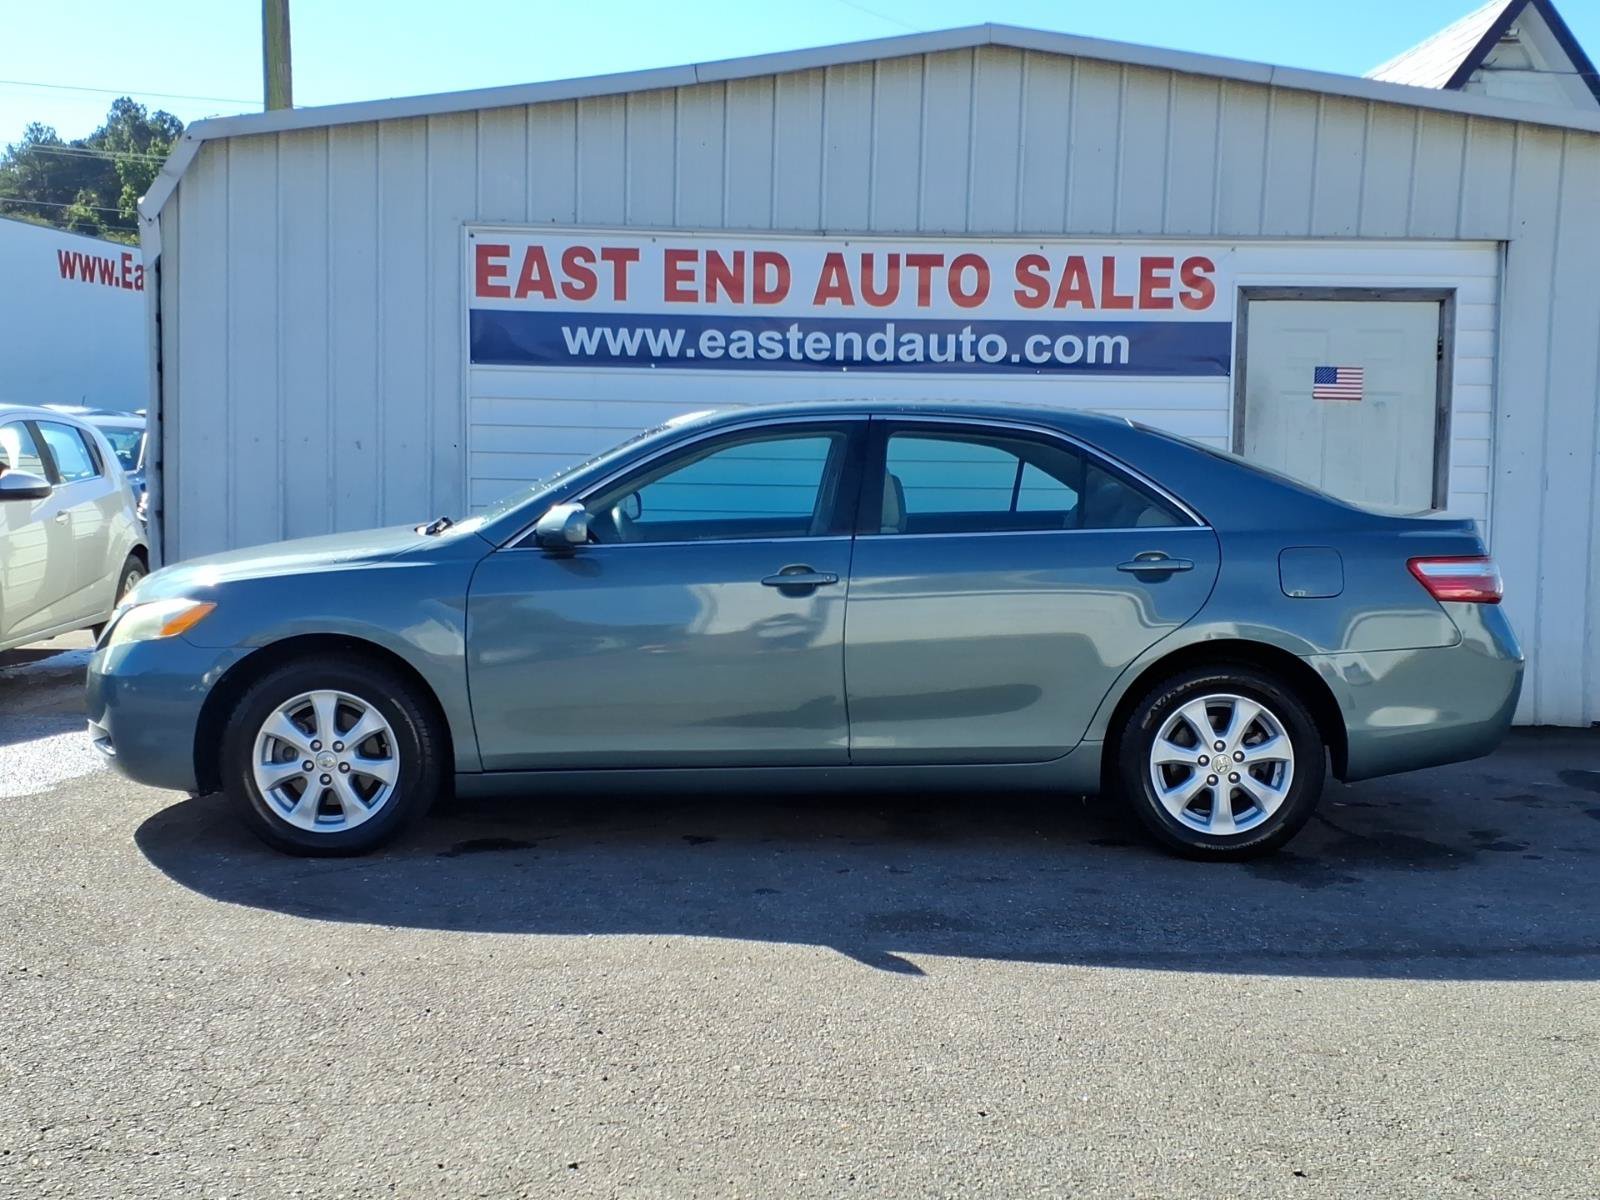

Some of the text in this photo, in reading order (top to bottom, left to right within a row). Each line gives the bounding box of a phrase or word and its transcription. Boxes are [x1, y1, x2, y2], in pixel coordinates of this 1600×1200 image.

[475, 244, 1216, 311] EAST END AUTO SALES
[561, 322, 1130, 365] www.eastendauto.com
